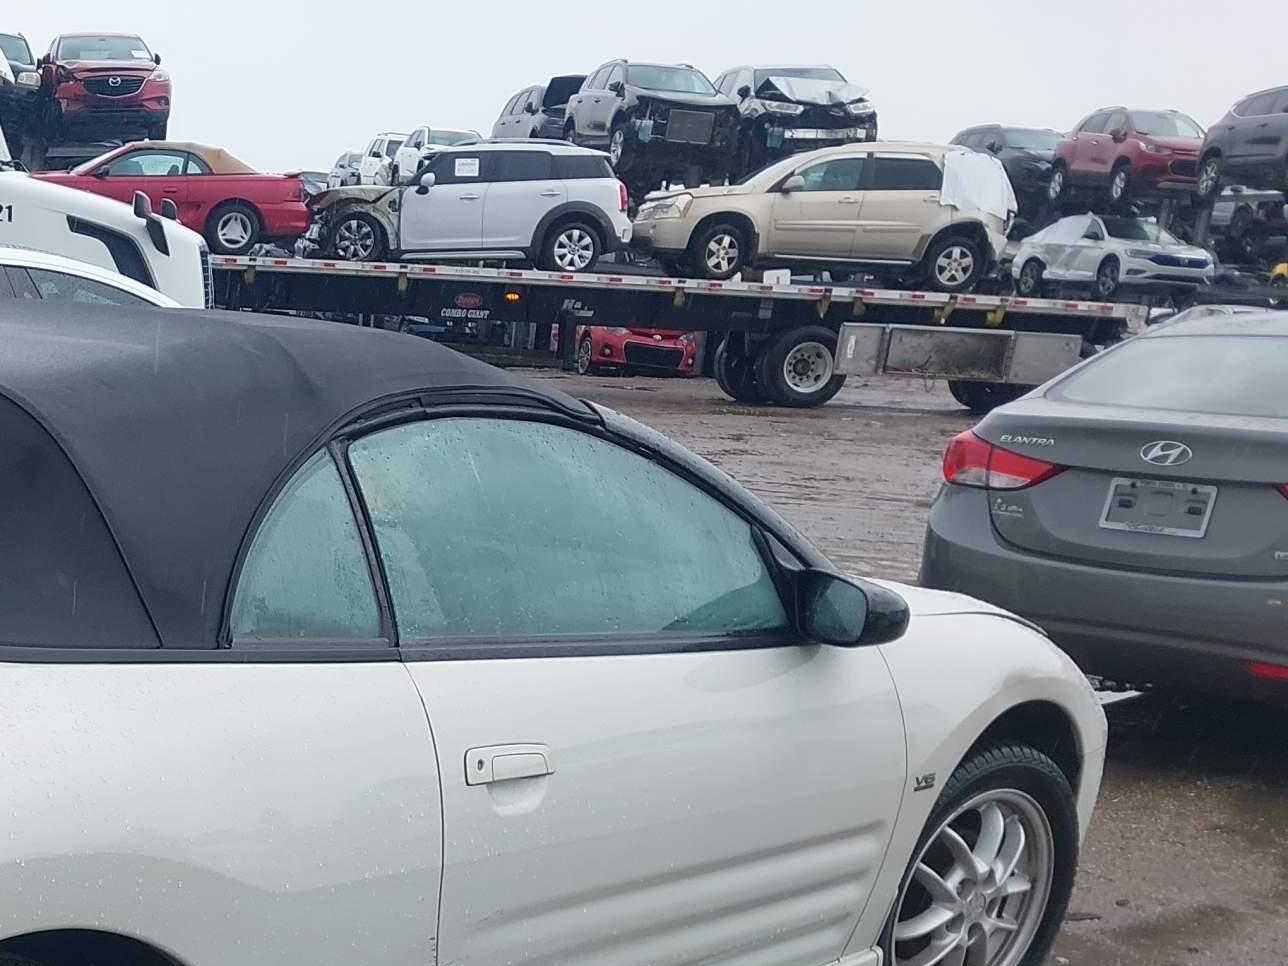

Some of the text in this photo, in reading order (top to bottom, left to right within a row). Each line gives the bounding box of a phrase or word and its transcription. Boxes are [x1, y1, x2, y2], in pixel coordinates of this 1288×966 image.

[441, 308, 467, 318] COMBO
[1000, 434, 1055, 446] ELANTRA
[915, 772, 936, 787] V6
